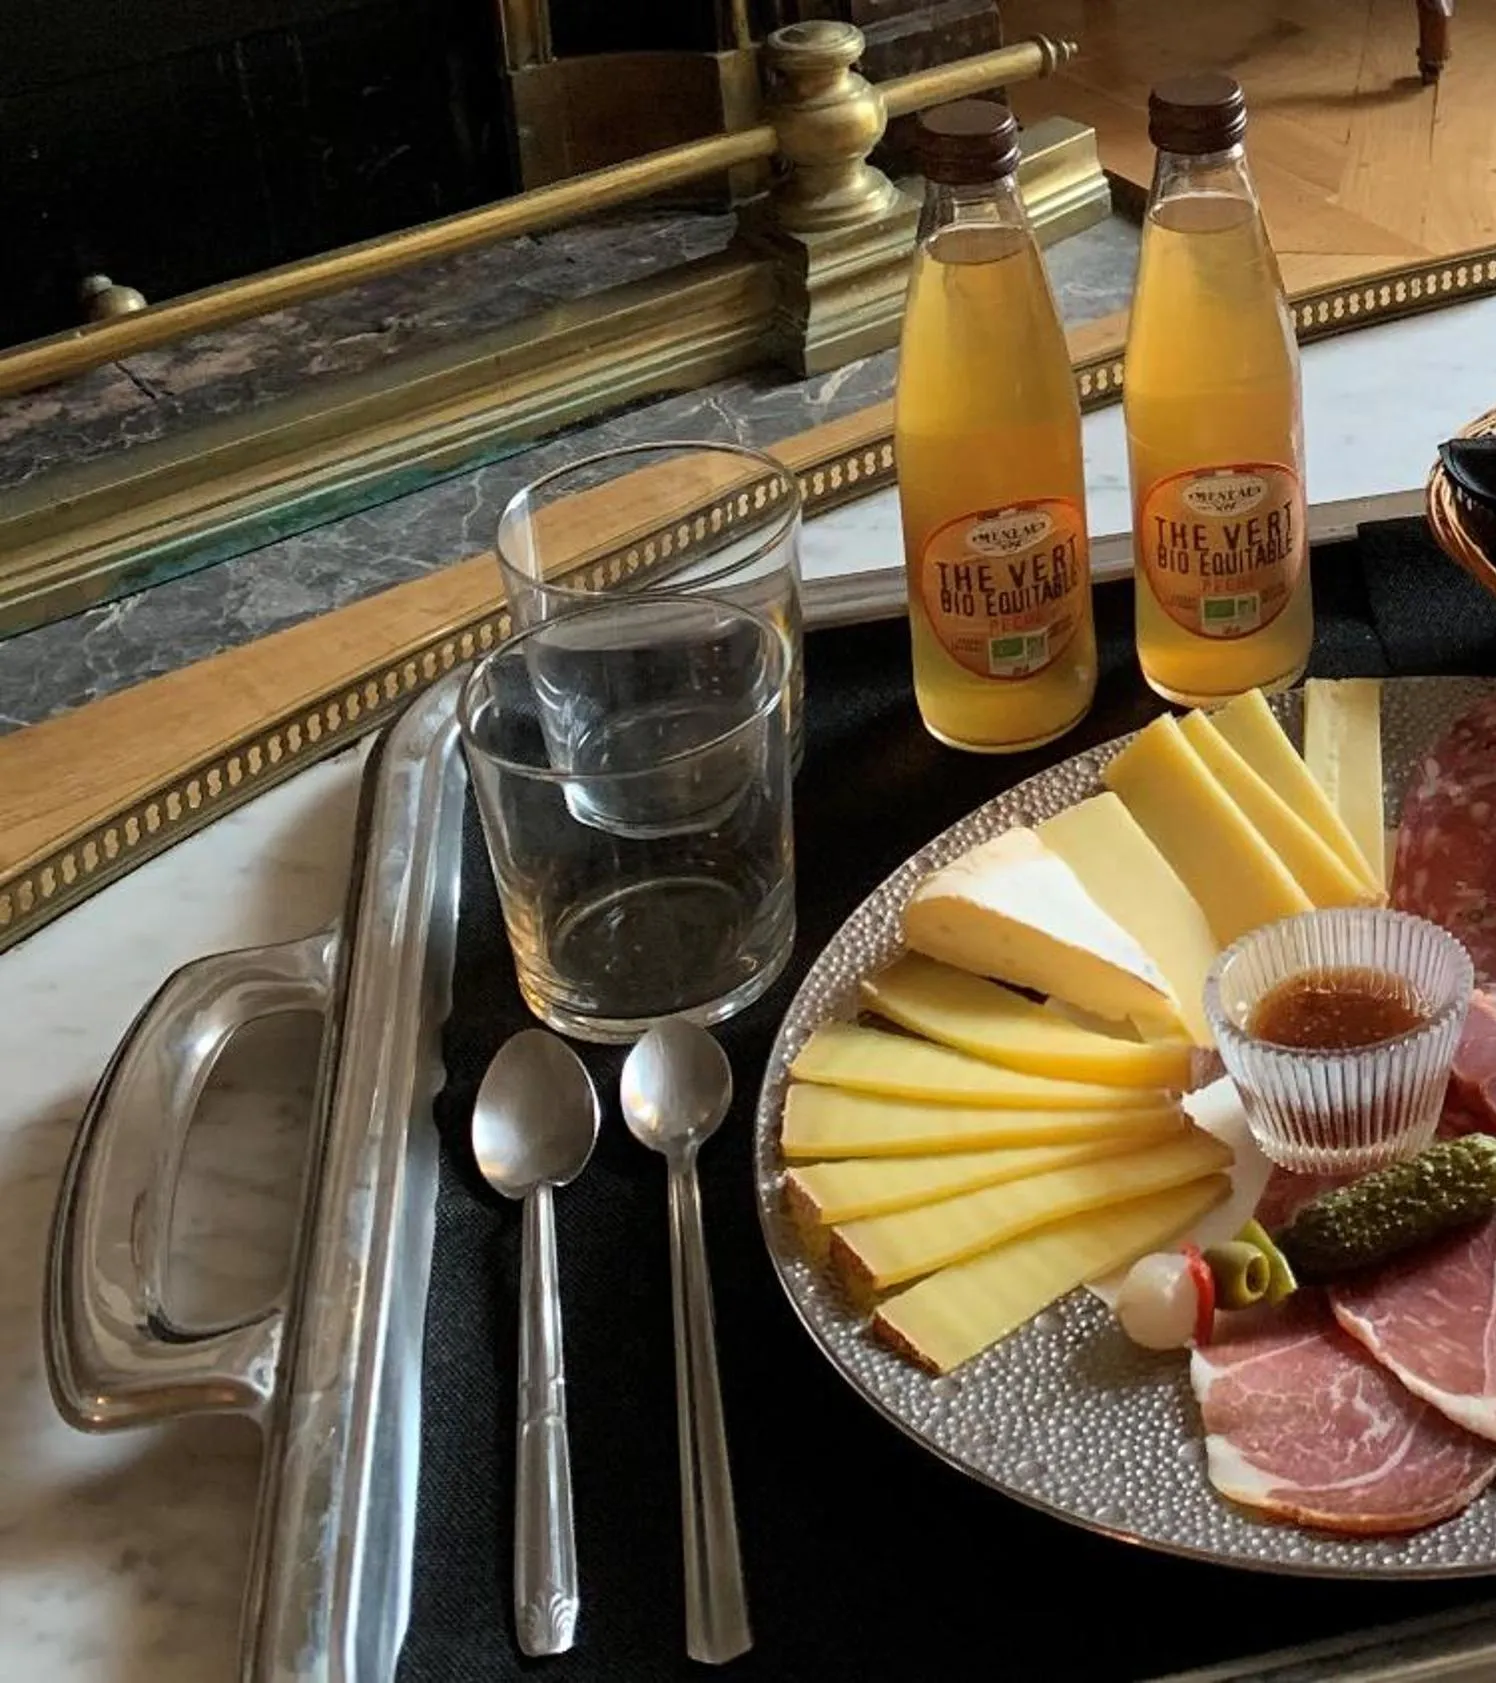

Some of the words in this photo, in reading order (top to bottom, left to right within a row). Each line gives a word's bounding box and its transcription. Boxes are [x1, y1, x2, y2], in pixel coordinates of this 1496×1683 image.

[1155, 516, 1207, 552] THE
[1222, 499, 1293, 551] VERT
[936, 562, 996, 594] THE
[1008, 534, 1078, 589] VERT
[1158, 545, 1190, 576] BIO
[1199, 533, 1293, 577] EQUITABLE
[940, 590, 975, 617] BIO
[986, 571, 1078, 617] EQUITABLE
